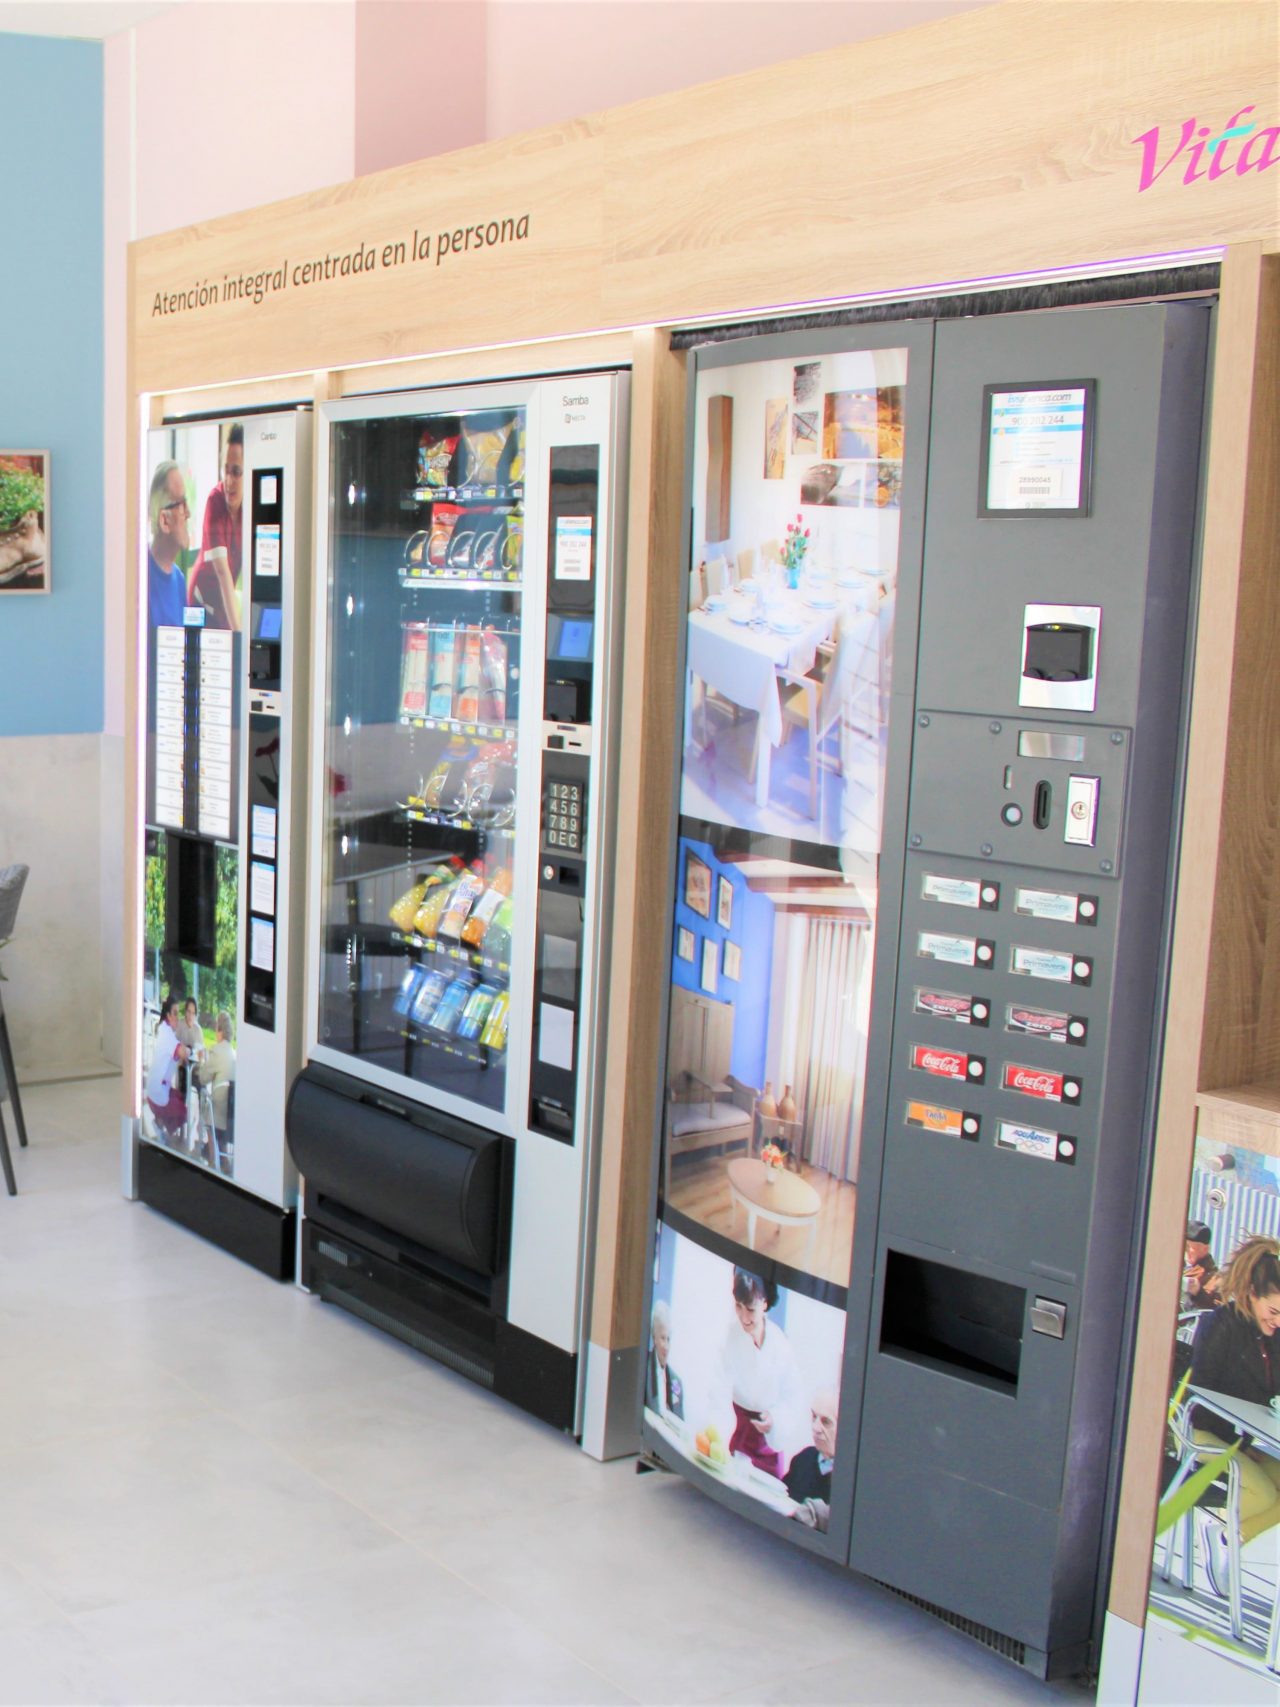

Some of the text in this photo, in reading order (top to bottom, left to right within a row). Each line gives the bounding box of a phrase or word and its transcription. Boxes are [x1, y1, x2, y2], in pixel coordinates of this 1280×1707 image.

[152, 214, 530, 317] Atención integral centrada en la persona
[562, 395, 589, 407] Samba
